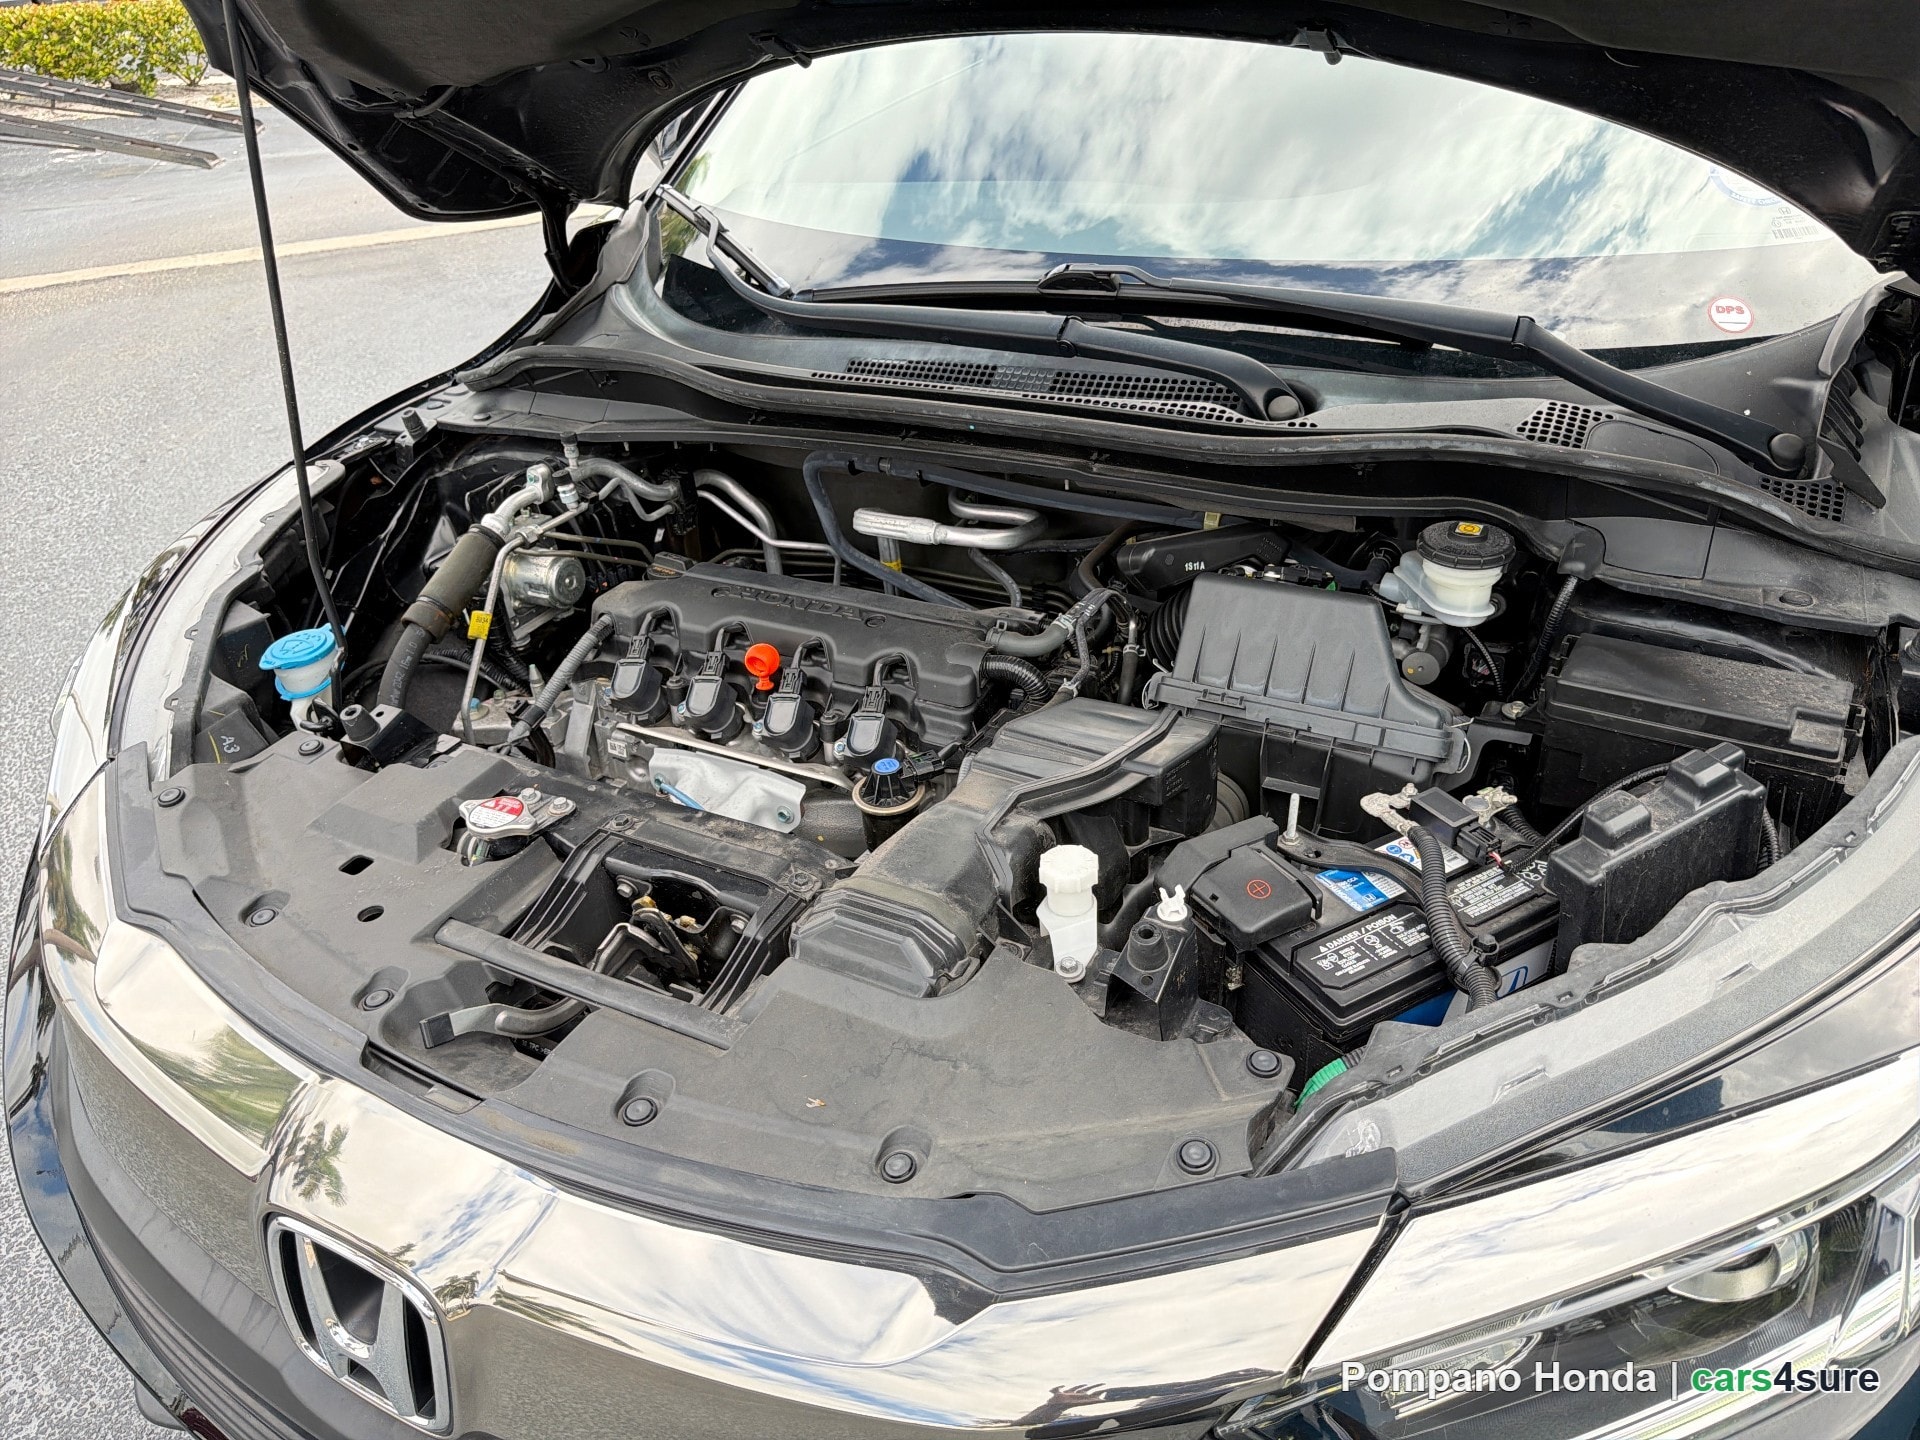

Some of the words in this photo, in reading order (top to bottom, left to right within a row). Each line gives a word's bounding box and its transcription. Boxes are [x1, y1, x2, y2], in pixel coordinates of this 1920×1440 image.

[1715, 305, 1745, 314] DPS
[727, 584, 863, 622] HONDA
[220, 735, 241, 754] A3
[1325, 929, 1362, 950] DANGER
[1366, 913, 1398, 932] POISON
